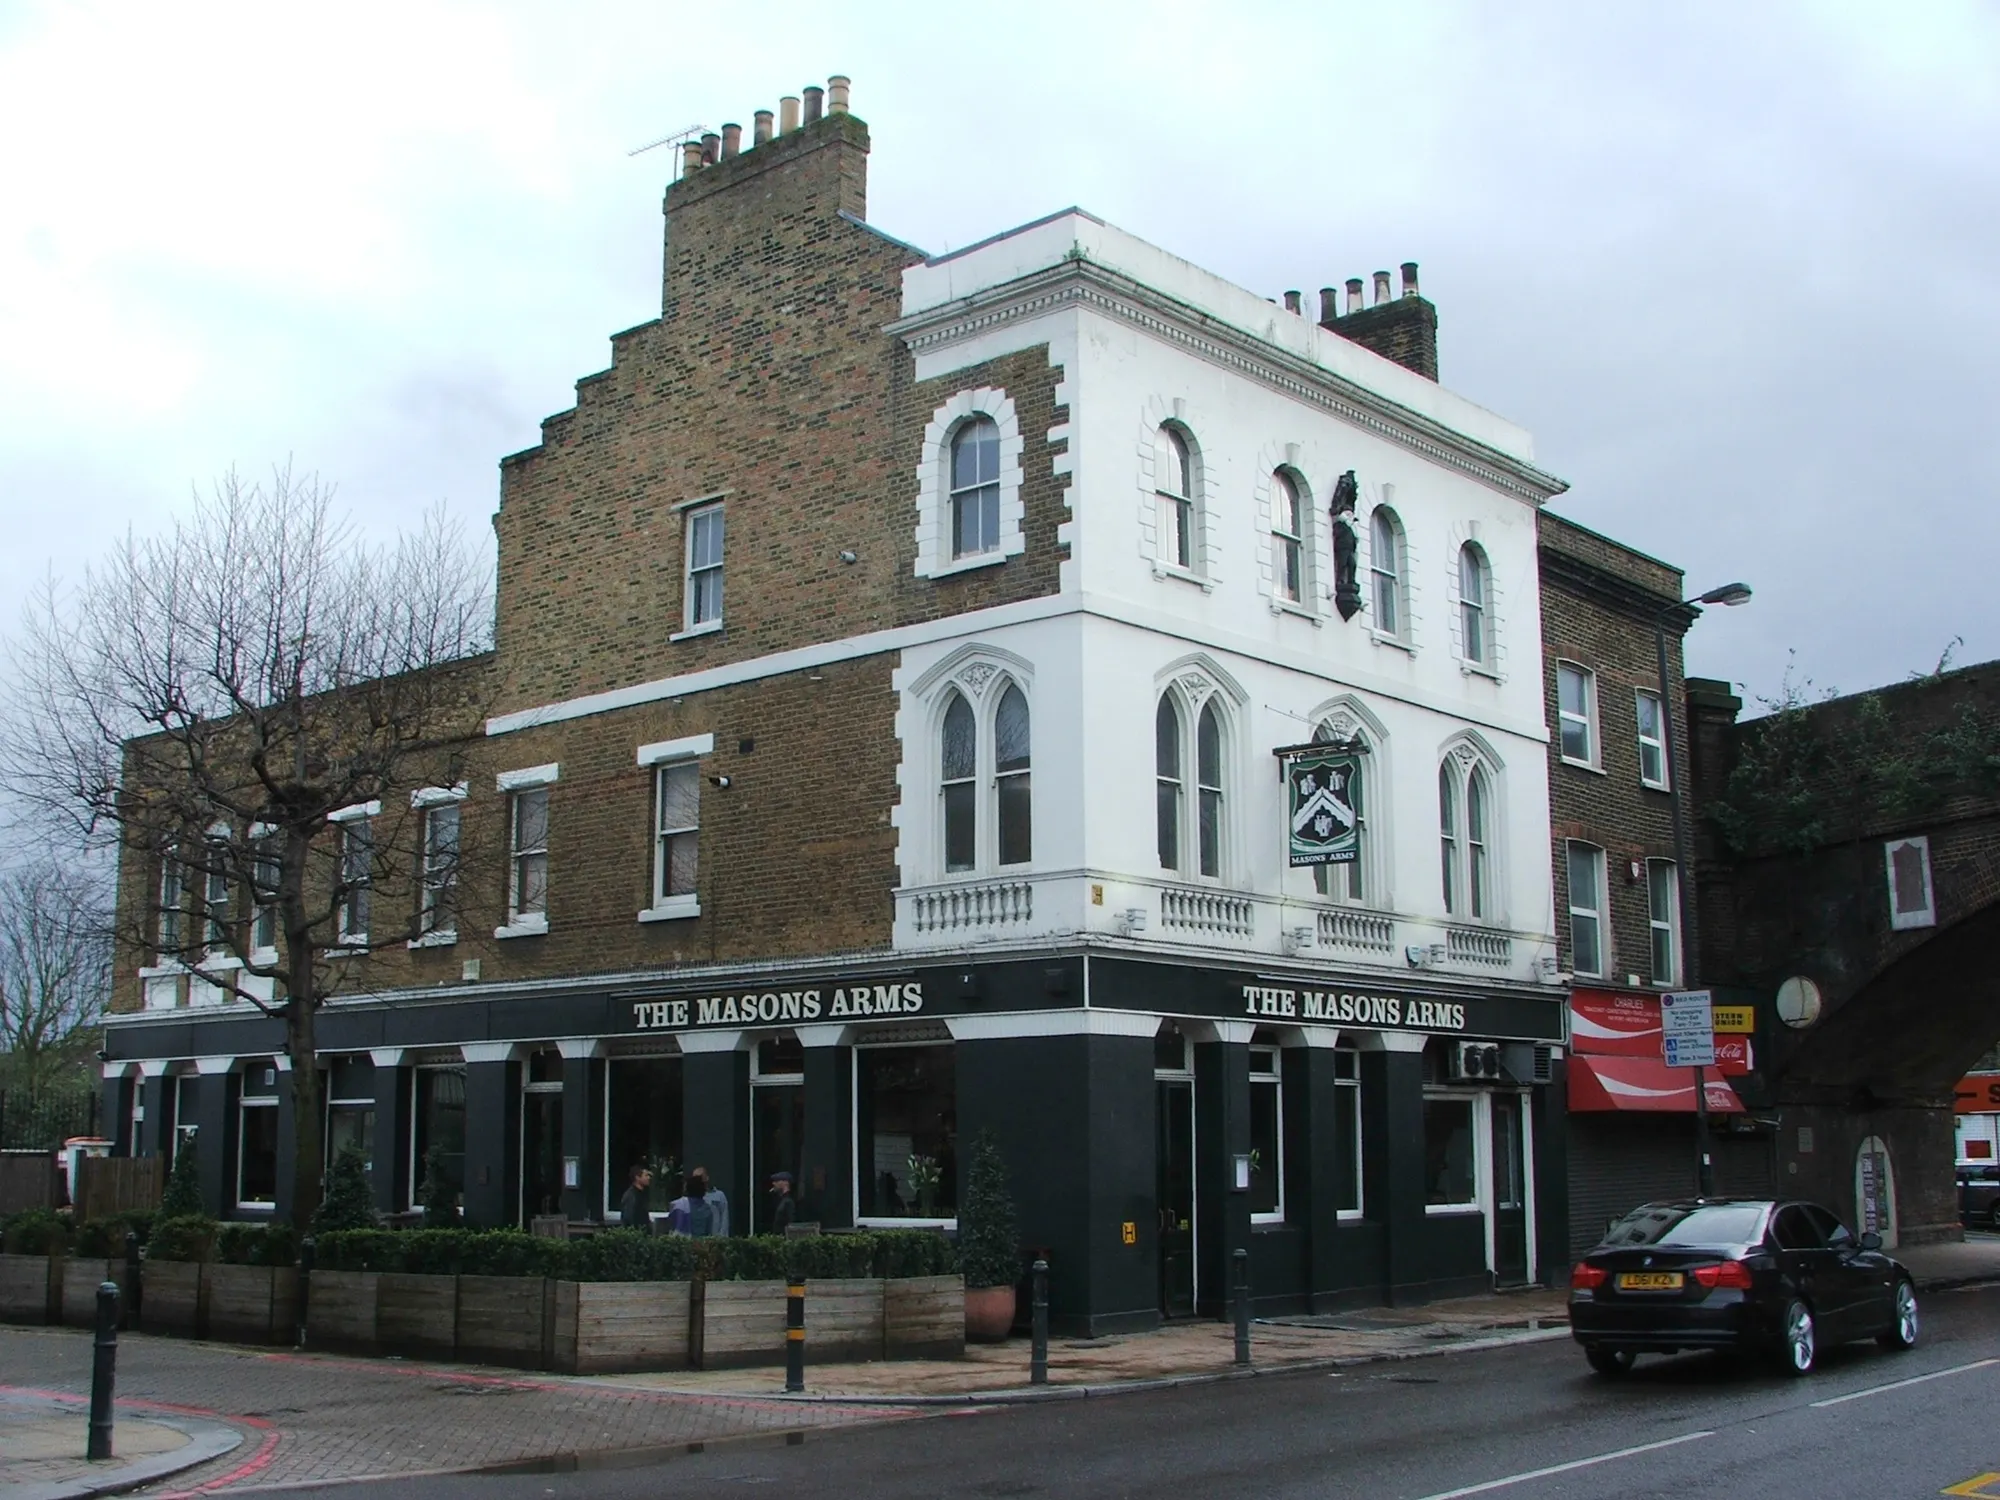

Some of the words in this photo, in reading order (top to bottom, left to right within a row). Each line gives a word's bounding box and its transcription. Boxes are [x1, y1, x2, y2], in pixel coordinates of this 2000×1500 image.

[1291, 854, 1326, 864] MASONS
[1329, 851, 1355, 860] ARMS
[633, 1000, 689, 1028] THE
[696, 990, 822, 1025] MASONS
[828, 982, 923, 1017] ARMS
[1242, 986, 1296, 1017] THE
[1302, 991, 1401, 1025] MASONS
[1405, 1000, 1465, 1030] ARMS
